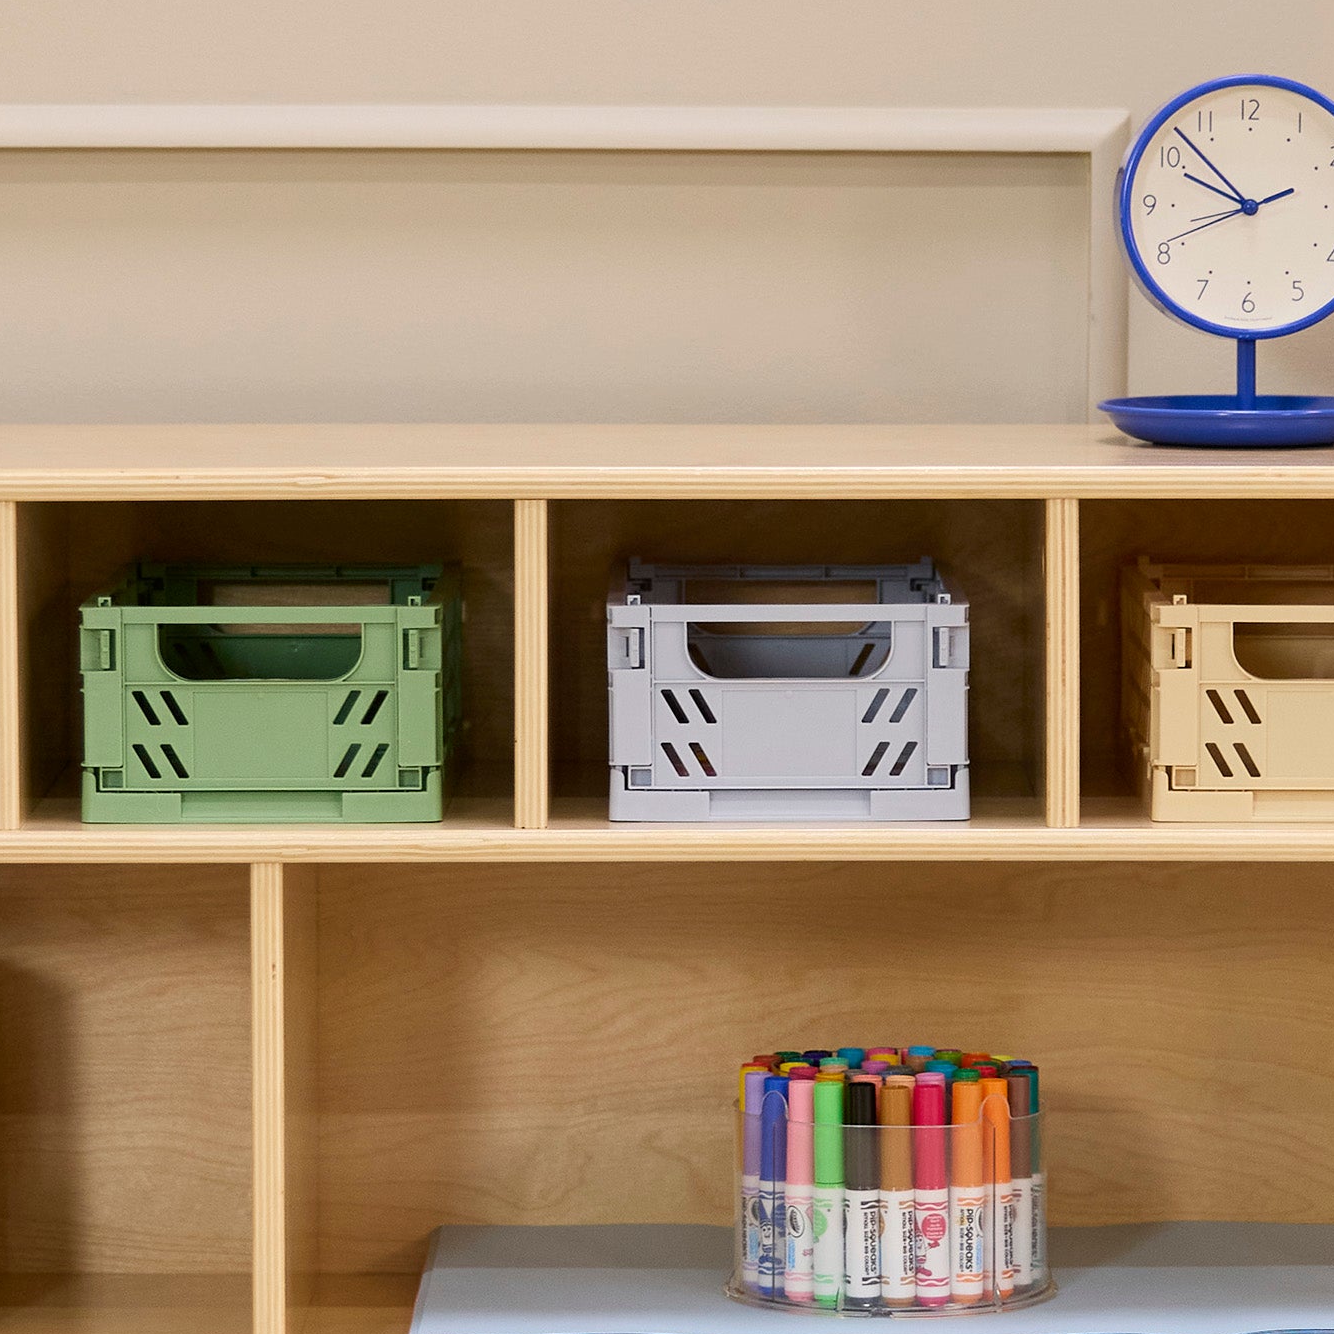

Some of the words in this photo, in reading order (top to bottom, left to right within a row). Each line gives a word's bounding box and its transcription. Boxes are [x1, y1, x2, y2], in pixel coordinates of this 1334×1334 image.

[1241, 98, 1260, 121] 12
[1197, 111, 1213, 133] 11
[1159, 146, 1181, 168] 10
[1143, 194, 1157, 216] 9
[1157, 242, 1171, 265] 8
[1196, 279, 1209, 300] 7
[1291, 280, 1305, 302] 5
[1241, 291, 1255, 313] 6
